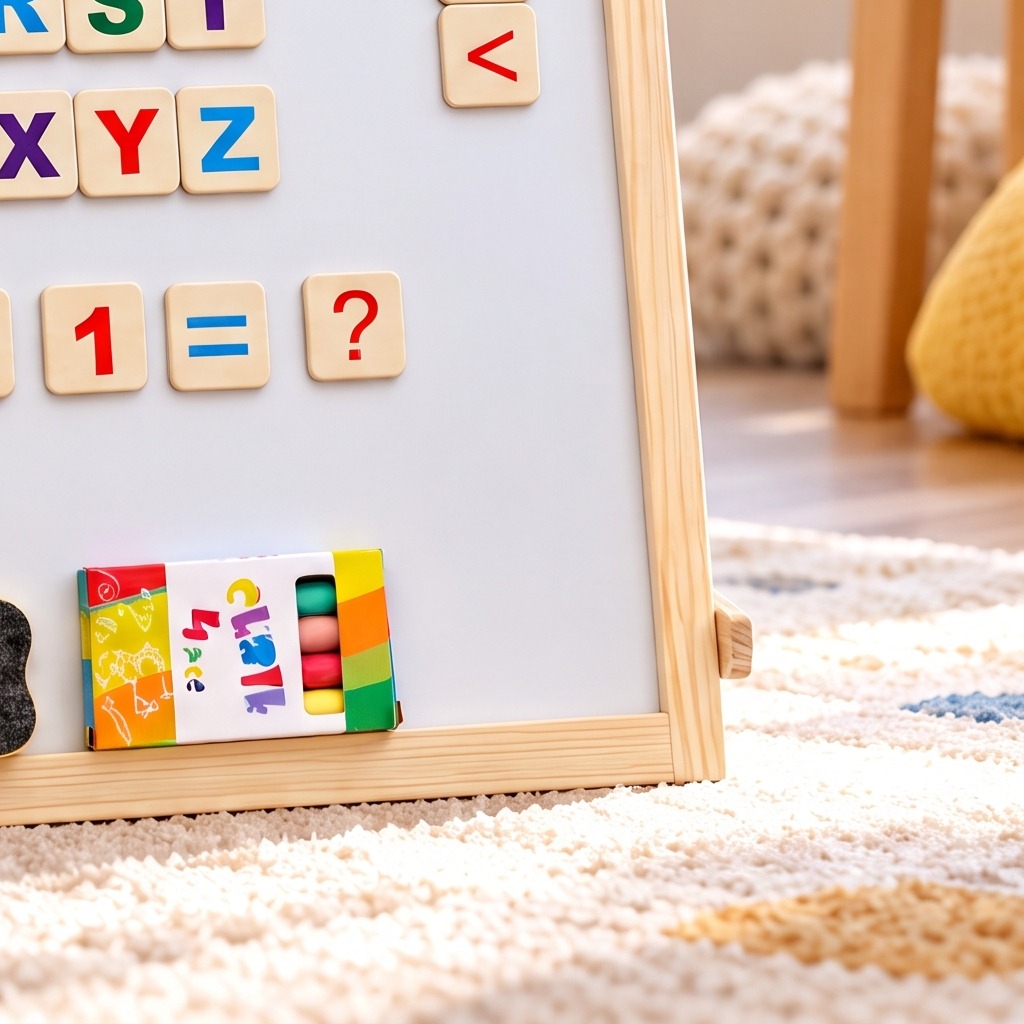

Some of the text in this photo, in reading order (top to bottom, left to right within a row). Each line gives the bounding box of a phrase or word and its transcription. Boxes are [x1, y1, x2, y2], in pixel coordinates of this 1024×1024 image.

[468, 31, 517, 81] <
[96, 109, 158, 175] Y
[200, 106, 259, 172] Z
[75, 307, 113, 375] 1
[187, 315, 248, 357] =
[334, 290, 378, 360] ?
